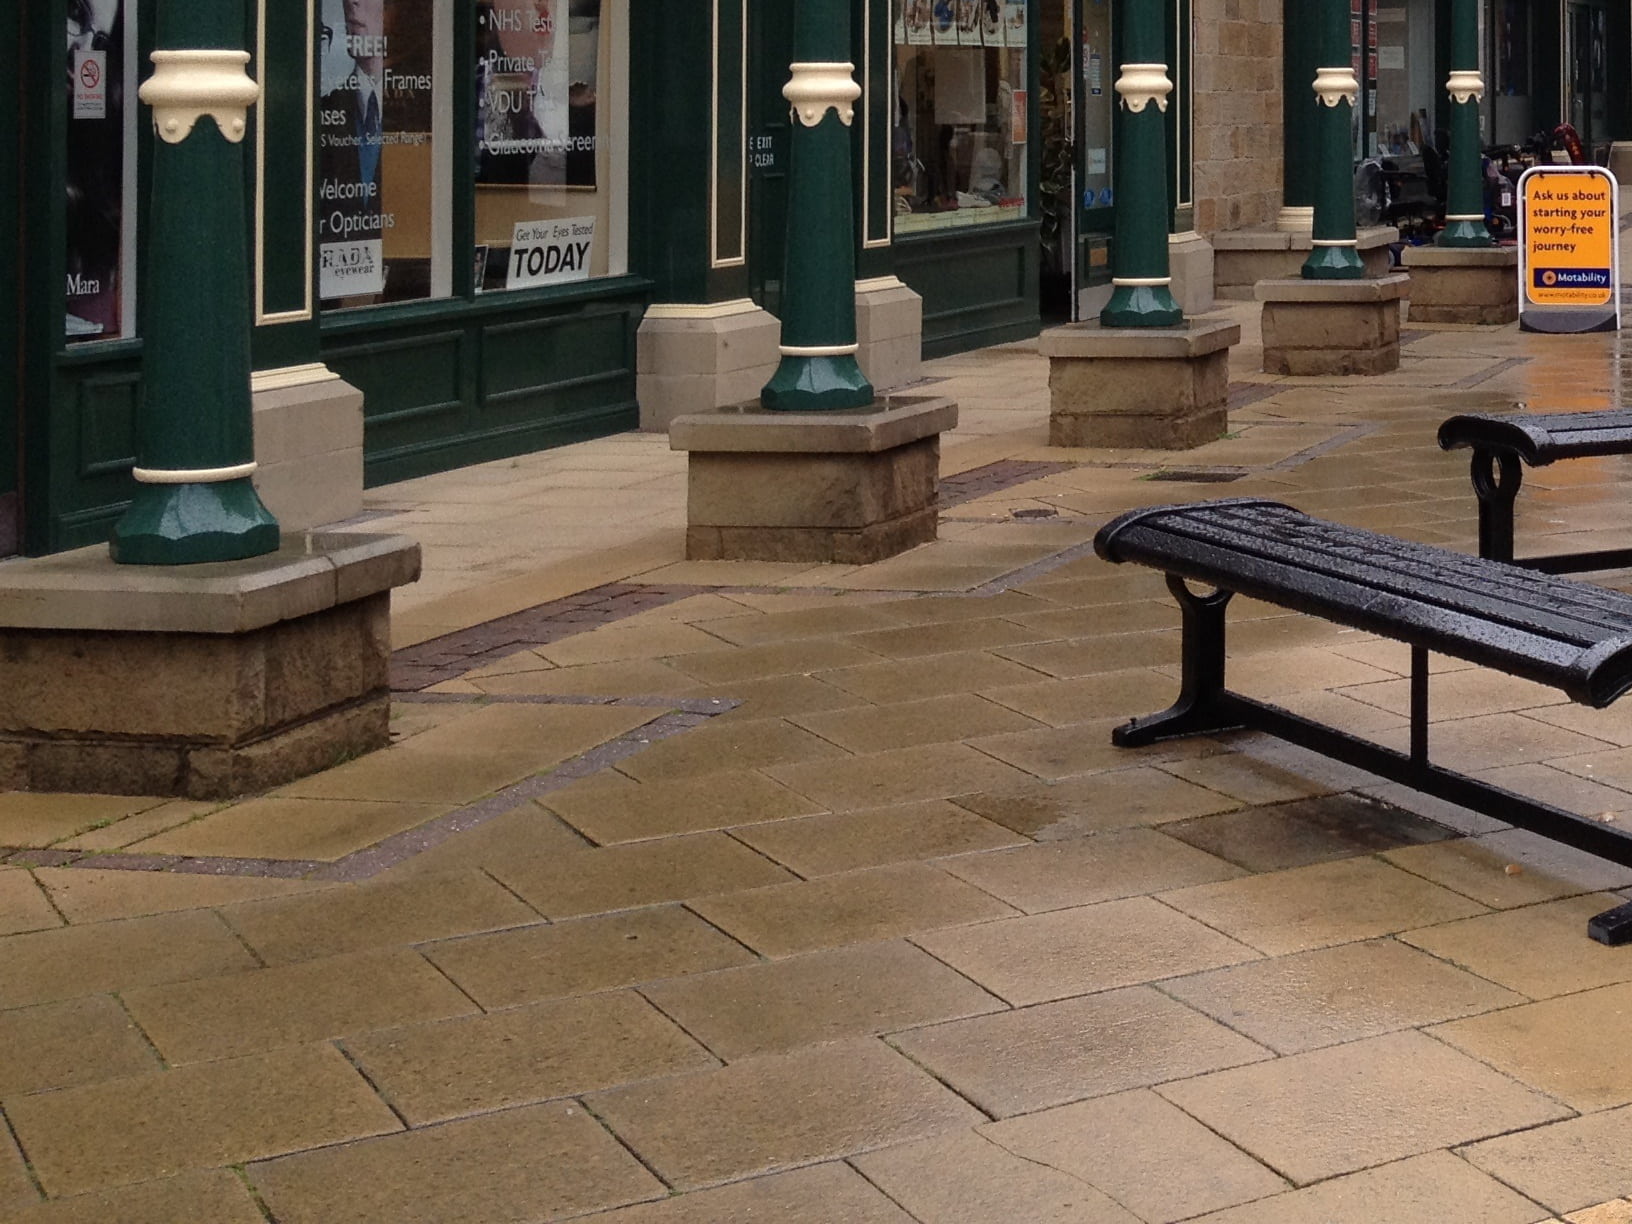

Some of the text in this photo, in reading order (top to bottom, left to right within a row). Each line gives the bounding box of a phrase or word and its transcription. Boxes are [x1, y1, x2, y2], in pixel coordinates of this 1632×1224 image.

[489, 9, 522, 32] NHS
[489, 50, 535, 72] Private
[384, 68, 432, 91] Frames
[487, 90, 522, 114] VDU
[1533, 190, 1606, 201] Ask us about
[1533, 208, 1606, 220] starting your
[330, 210, 395, 238] Opticians
[572, 222, 594, 236] Tested
[1533, 223, 1594, 236] worry-free
[321, 246, 374, 268] RADA
[1533, 242, 1576, 254] journey
[514, 241, 590, 278] TODAY
[335, 264, 375, 280] eyewear
[1557, 272, 1607, 284] Motability
